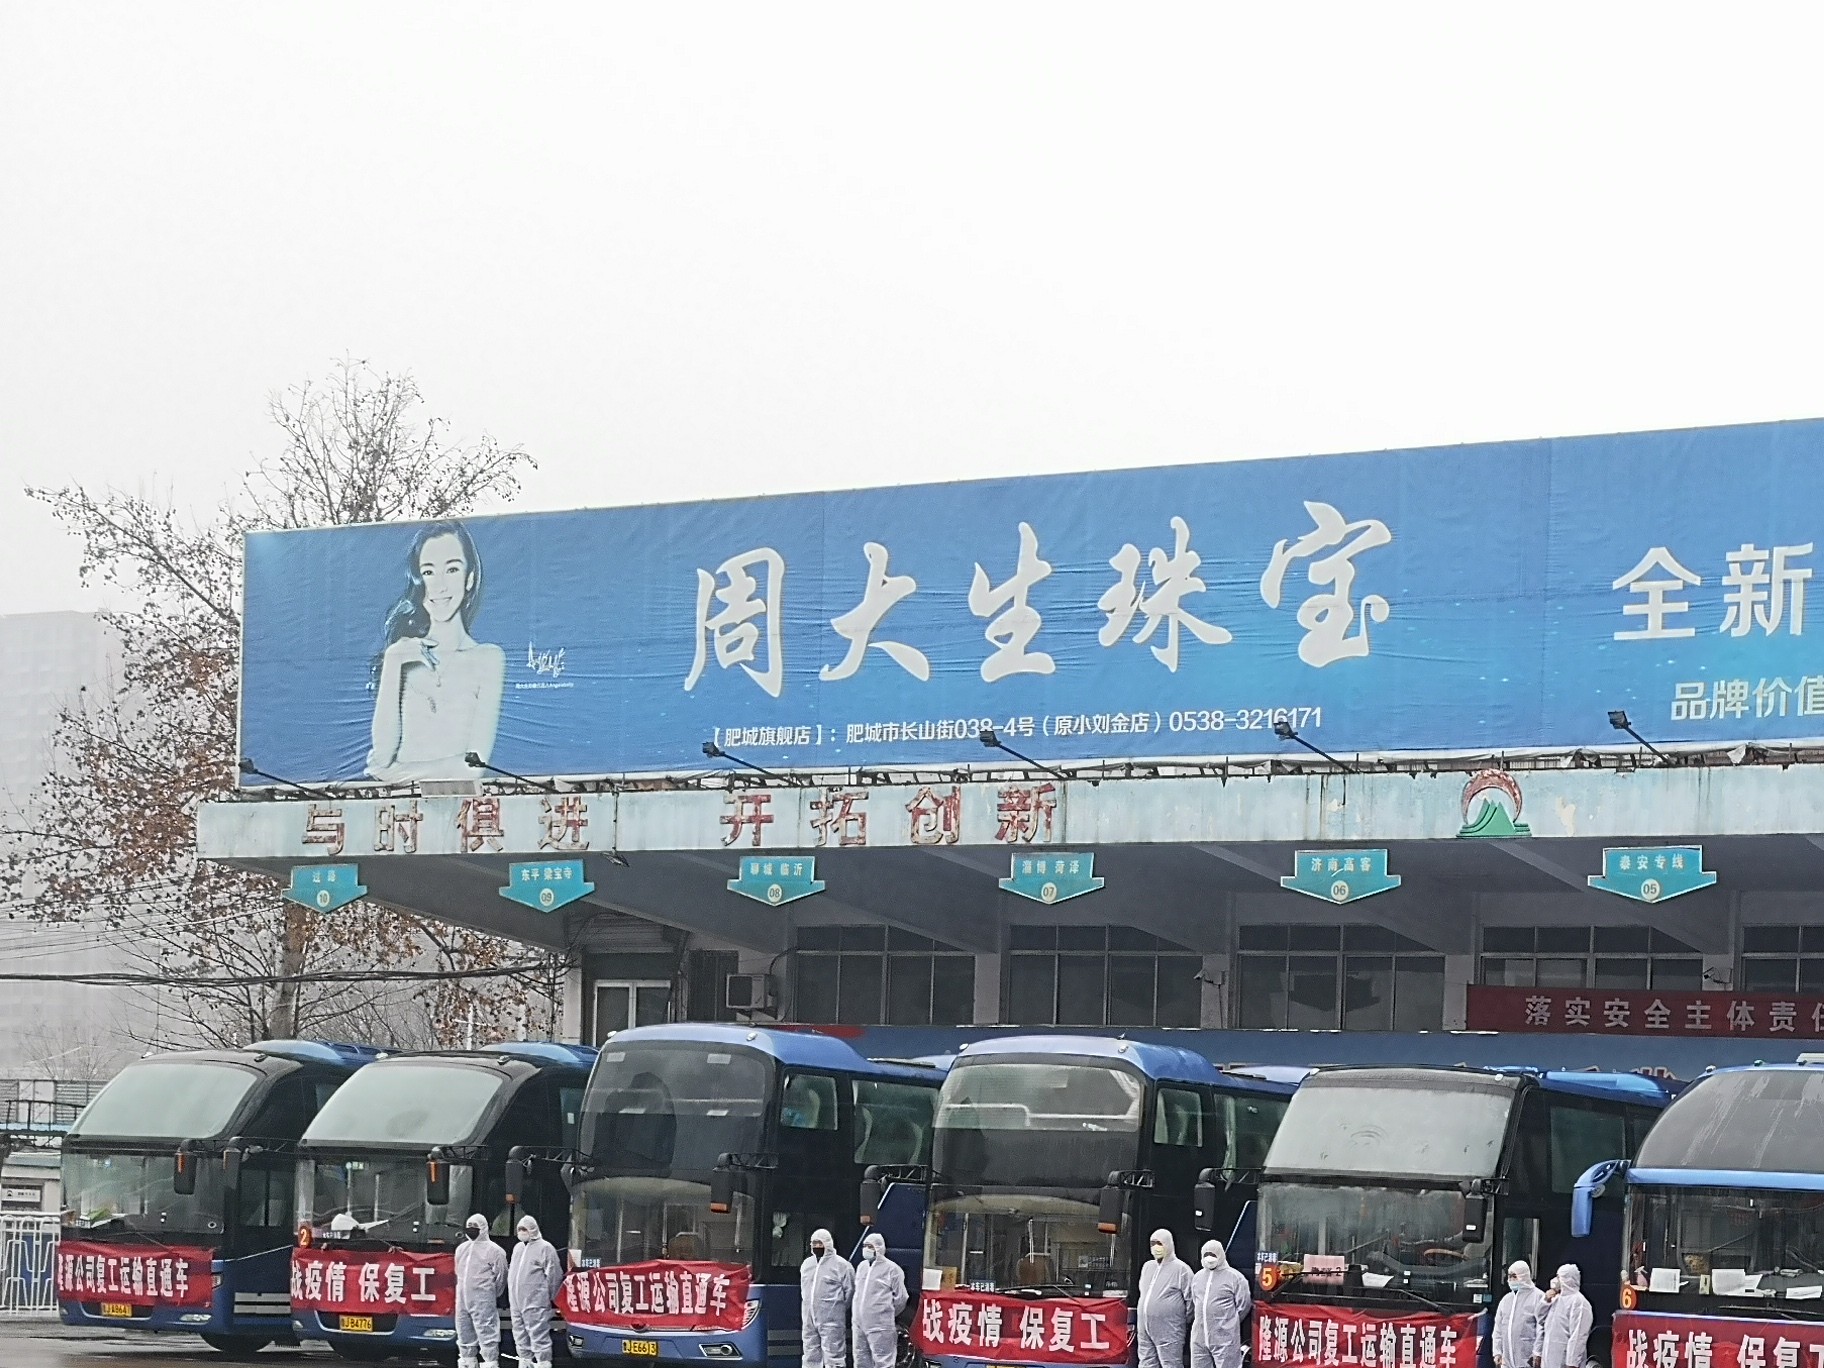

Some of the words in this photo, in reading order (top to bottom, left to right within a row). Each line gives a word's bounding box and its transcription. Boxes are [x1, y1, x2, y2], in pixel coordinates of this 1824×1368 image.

[684, 500, 1393, 698] 周大生珠宝
[302, 794, 591, 857] 与时俱进
[720, 781, 1058, 848] 开拓创新
[1618, 854, 1685, 871] 泰安专线
[768, 887, 781, 899] 08
[1042, 886, 1055, 898] 07
[1332, 884, 1347, 897] 06
[1643, 882, 1658, 895] 05
[300, 1229, 307, 1245] 2
[358, 1262, 437, 1304] 保复工
[1262, 1267, 1273, 1287] 5
[1621, 1288, 1633, 1309] 6
[922, 1299, 1003, 1348] 战疫情
[1019, 1305, 1111, 1353] 保复工
